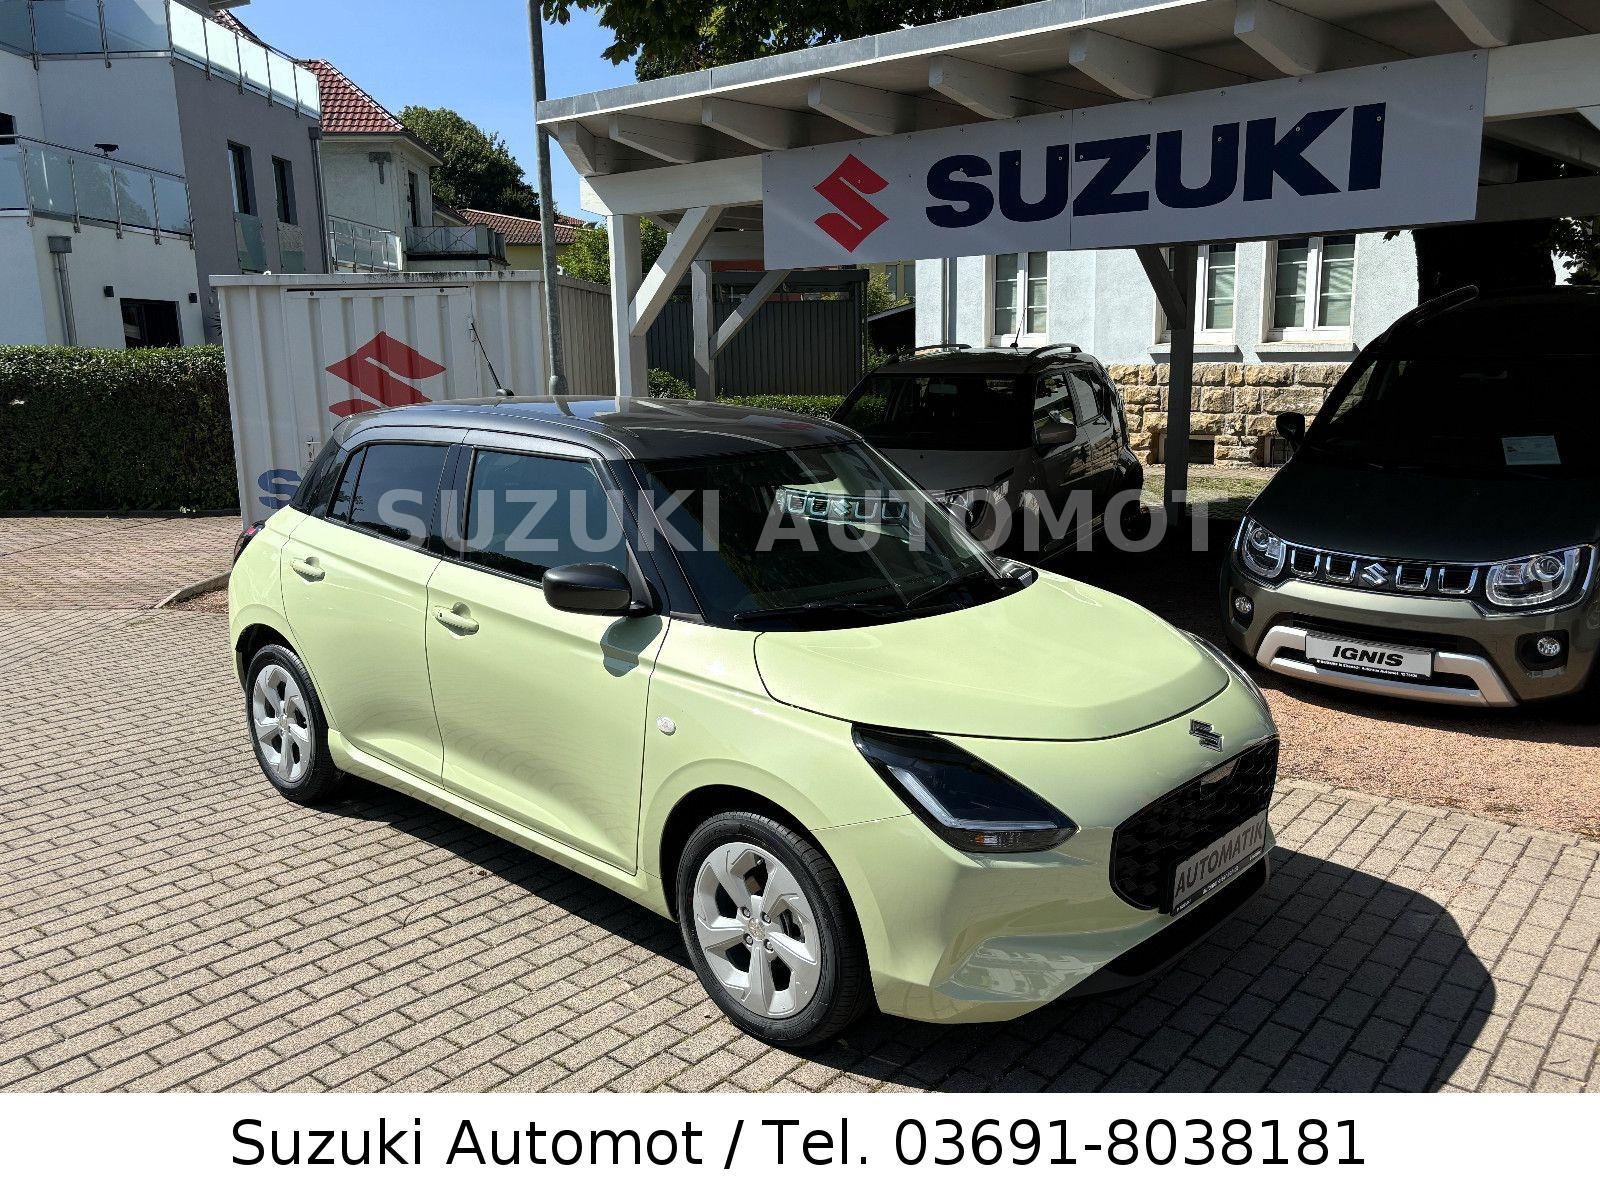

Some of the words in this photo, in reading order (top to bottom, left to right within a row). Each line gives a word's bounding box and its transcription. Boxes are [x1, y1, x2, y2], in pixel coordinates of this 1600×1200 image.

[926, 102, 1387, 228] SUZUKI
[1332, 645, 1404, 667] IGNIS
[1174, 819, 1266, 898] AUTOMATIK
